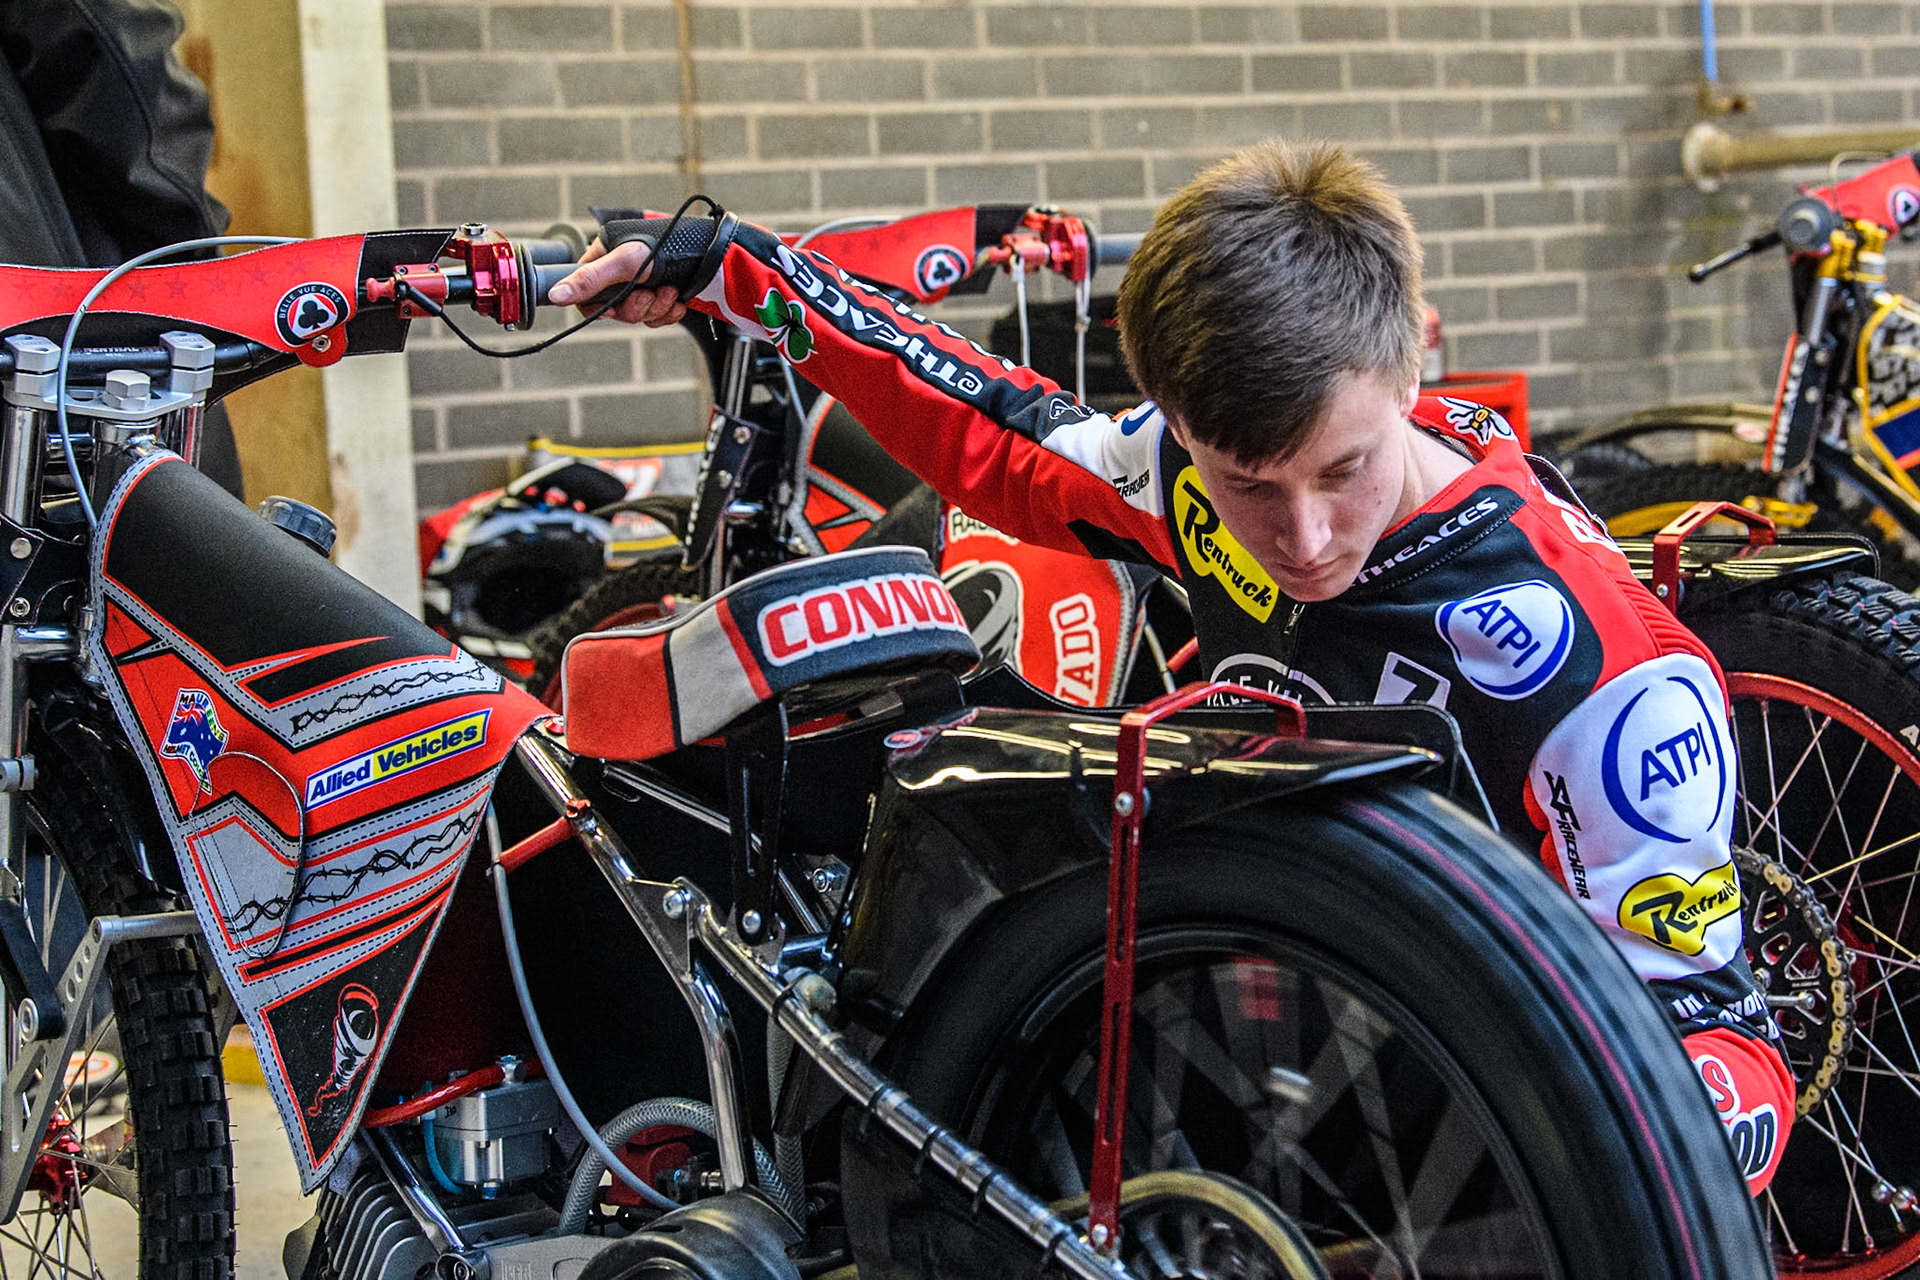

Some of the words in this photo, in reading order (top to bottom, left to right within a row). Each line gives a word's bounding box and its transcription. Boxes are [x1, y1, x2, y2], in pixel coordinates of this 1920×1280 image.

[279, 293, 296, 319] BELLE
[298, 285, 317, 295] VUE
[320, 286, 341, 303] ACES
[1182, 480, 1273, 607] Rentruck
[1351, 497, 1499, 585] THEACES
[1462, 599, 1541, 669] ATPI
[310, 759, 371, 801] Allied
[377, 725, 478, 773] Vehicles
[1640, 722, 1711, 801] ATPI
